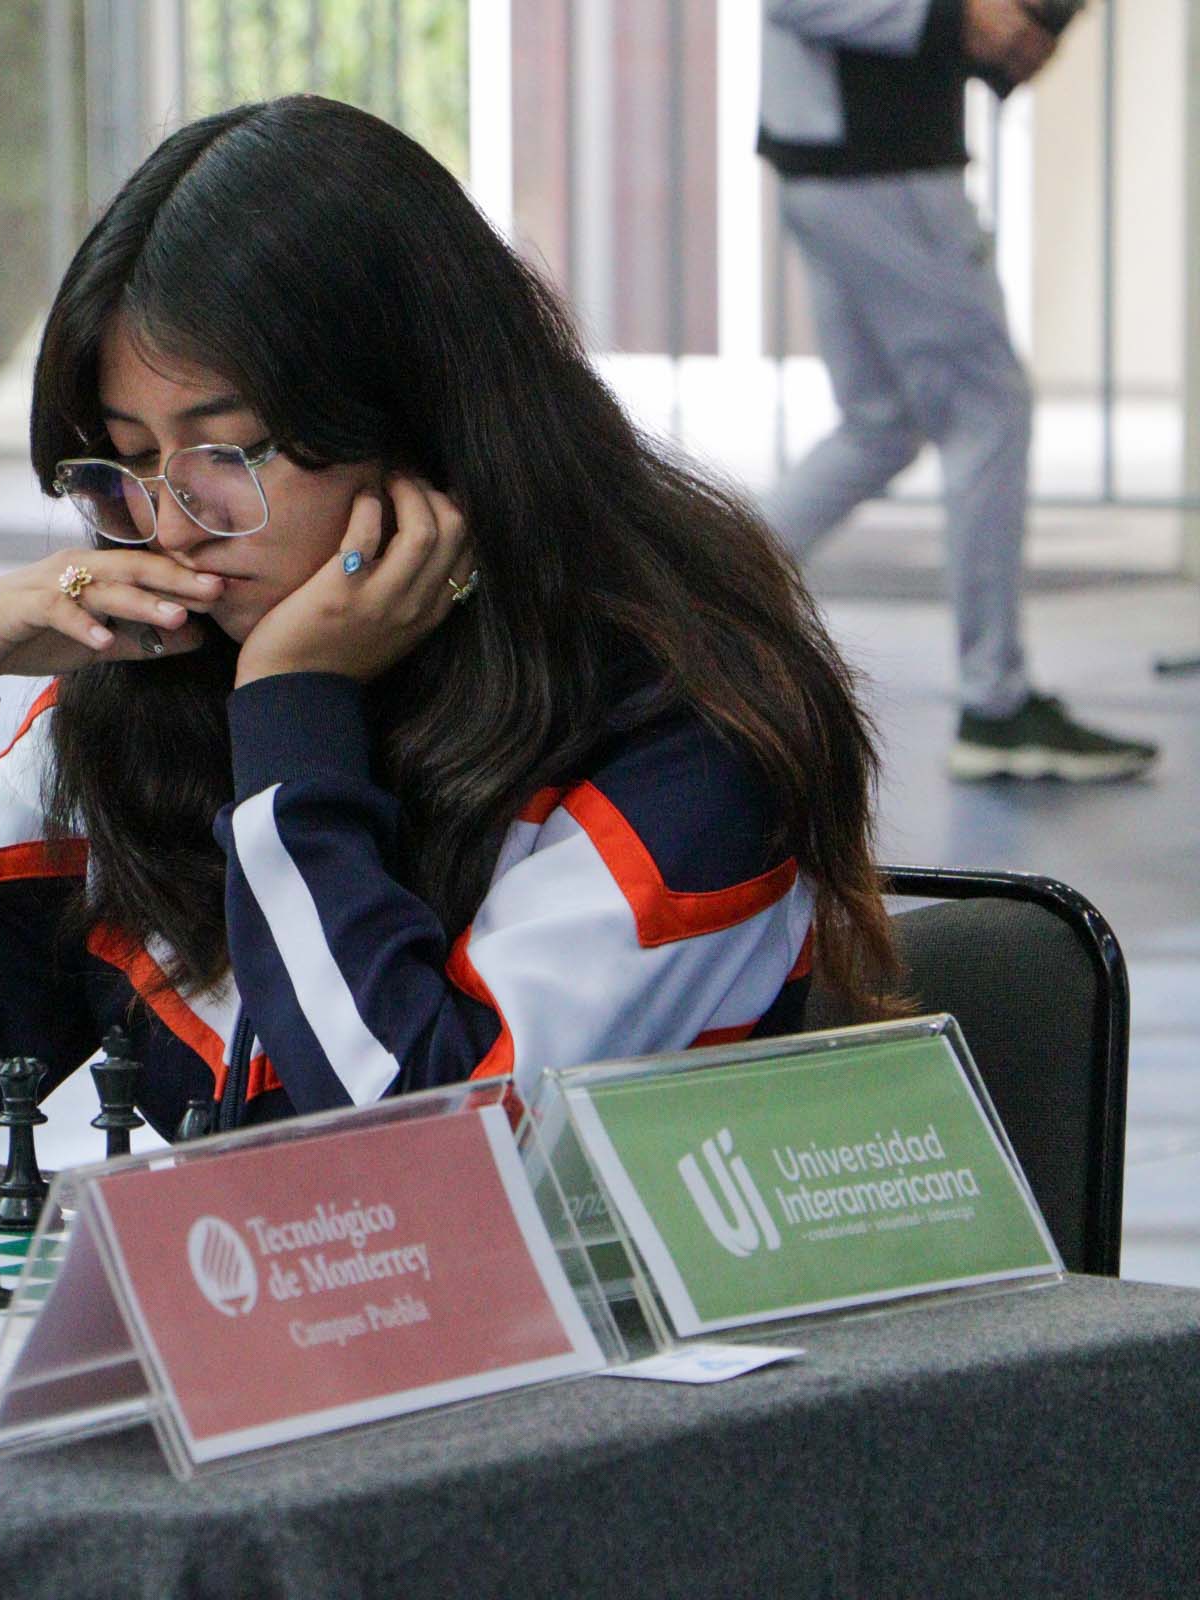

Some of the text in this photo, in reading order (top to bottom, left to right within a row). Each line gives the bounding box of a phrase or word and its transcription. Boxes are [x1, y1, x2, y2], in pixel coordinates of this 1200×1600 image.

[773, 1123, 946, 1183] Universidad
[775, 1167, 981, 1225] Interamericana
[246, 1199, 397, 1256] Tecnológico
[267, 1243, 432, 1301] de Monterrey
